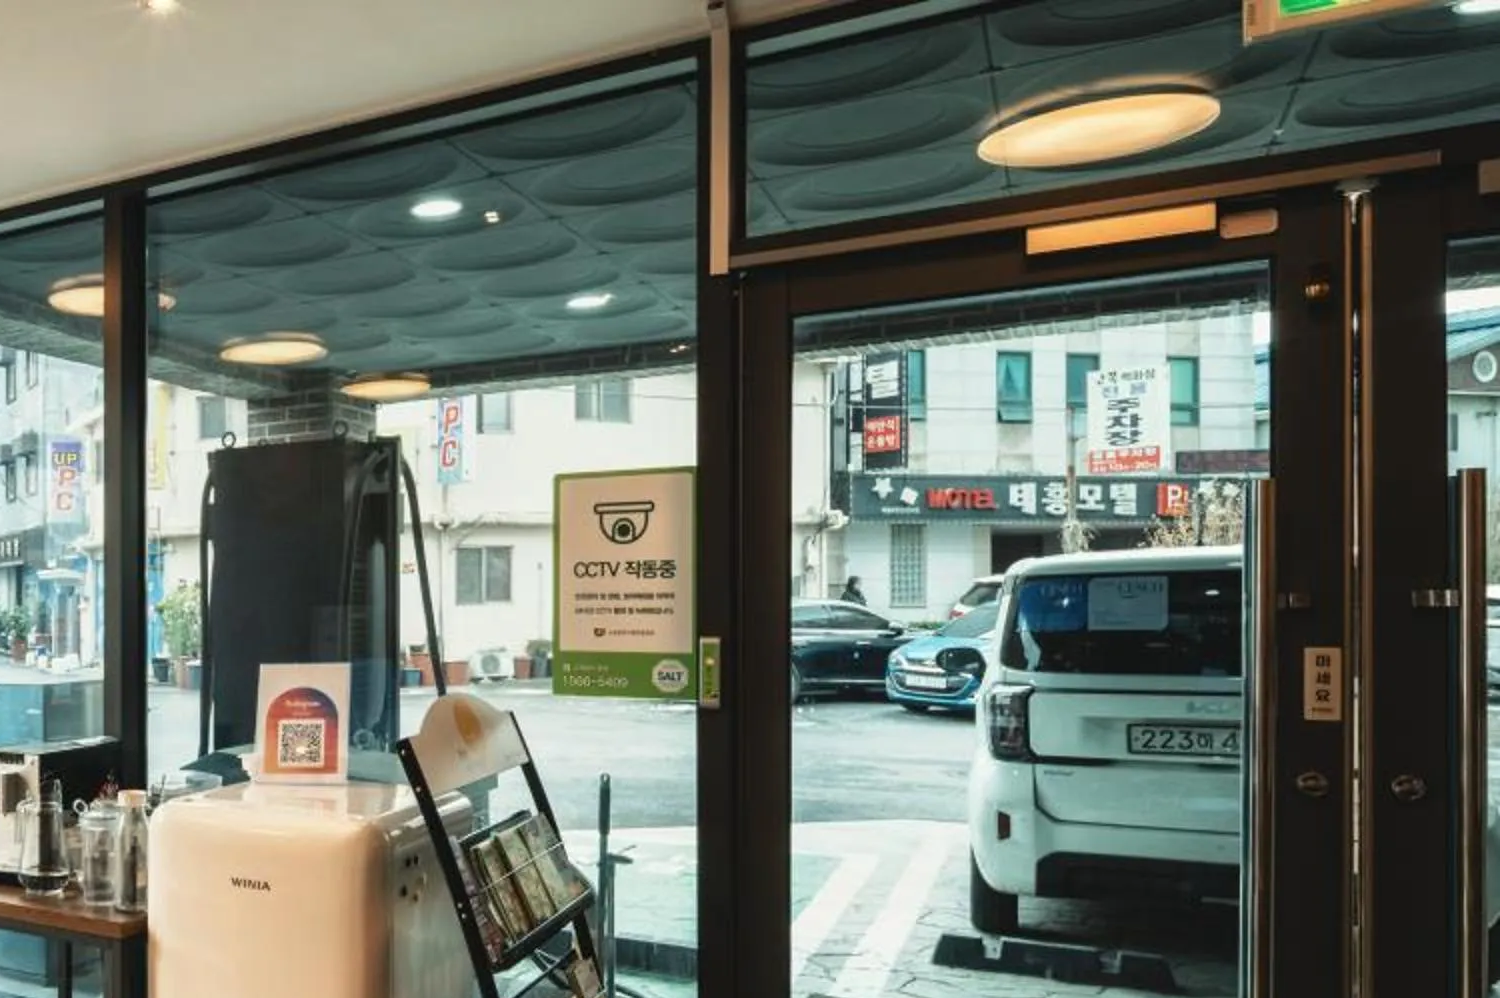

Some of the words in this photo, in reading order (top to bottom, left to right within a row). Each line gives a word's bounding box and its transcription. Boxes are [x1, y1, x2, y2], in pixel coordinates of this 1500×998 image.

[927, 487, 998, 511] MOTEL
[573, 561, 620, 578] CCTV
[624, 559, 677, 579] 작동중
[657, 670, 684, 682] SALT
[231, 877, 271, 892] WINIA
